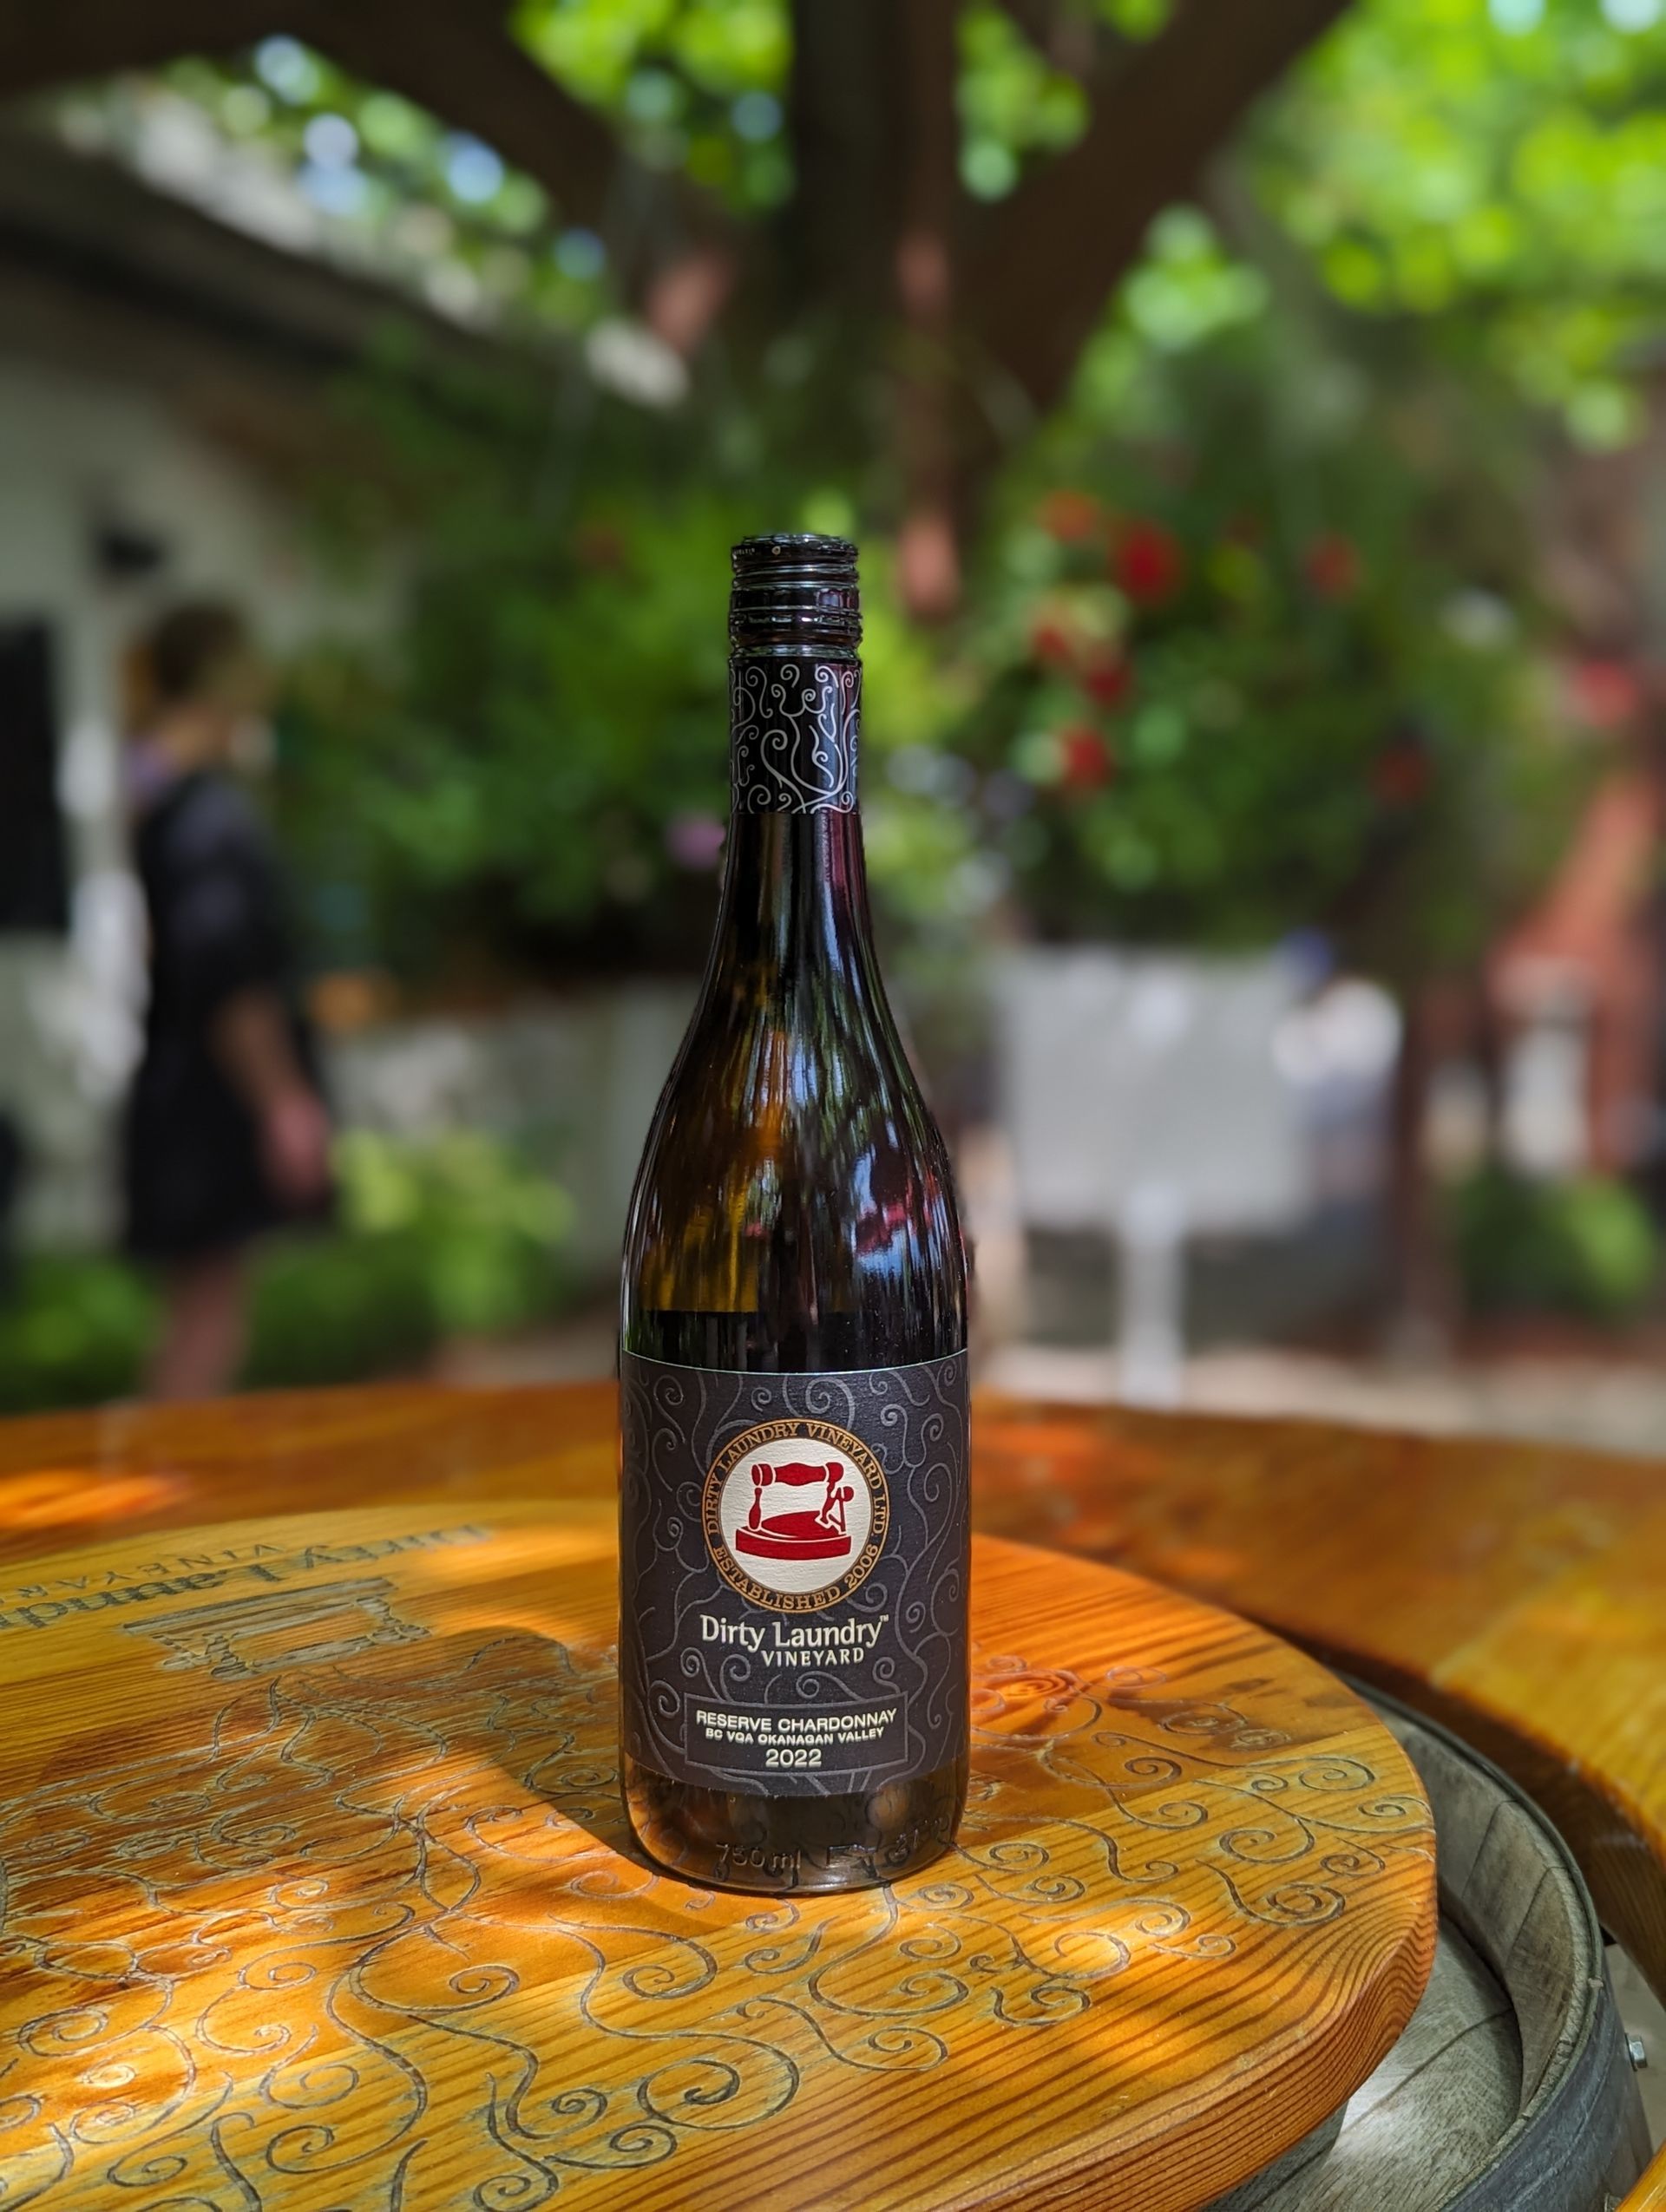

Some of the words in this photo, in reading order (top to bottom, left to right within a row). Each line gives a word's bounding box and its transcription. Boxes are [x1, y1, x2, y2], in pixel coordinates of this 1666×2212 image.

[706, 1473, 722, 1535] DIRTY
[718, 1423, 798, 1473] LAUNDRY
[806, 1423, 882, 1494] VINEYARD
[0, 1543, 285, 1603] VINEYAR
[713, 1546, 840, 1609] ESTABLISHED
[844, 1543, 878, 1589] 2006
[700, 1614, 765, 1652] Dirty
[761, 1648, 864, 1666] VINEYARD
[697, 1710, 771, 1732] RESERVE
[778, 1708, 897, 1733] CHARDONNAY
[705, 1727, 723, 1741] BC
[726, 1731, 754, 1745] VQA
[758, 1733, 833, 1746] OKANAGAN
[837, 1726, 884, 1744] VALLEY
[765, 1748, 822, 1768] 2022
[716, 1844, 764, 1867] 750
